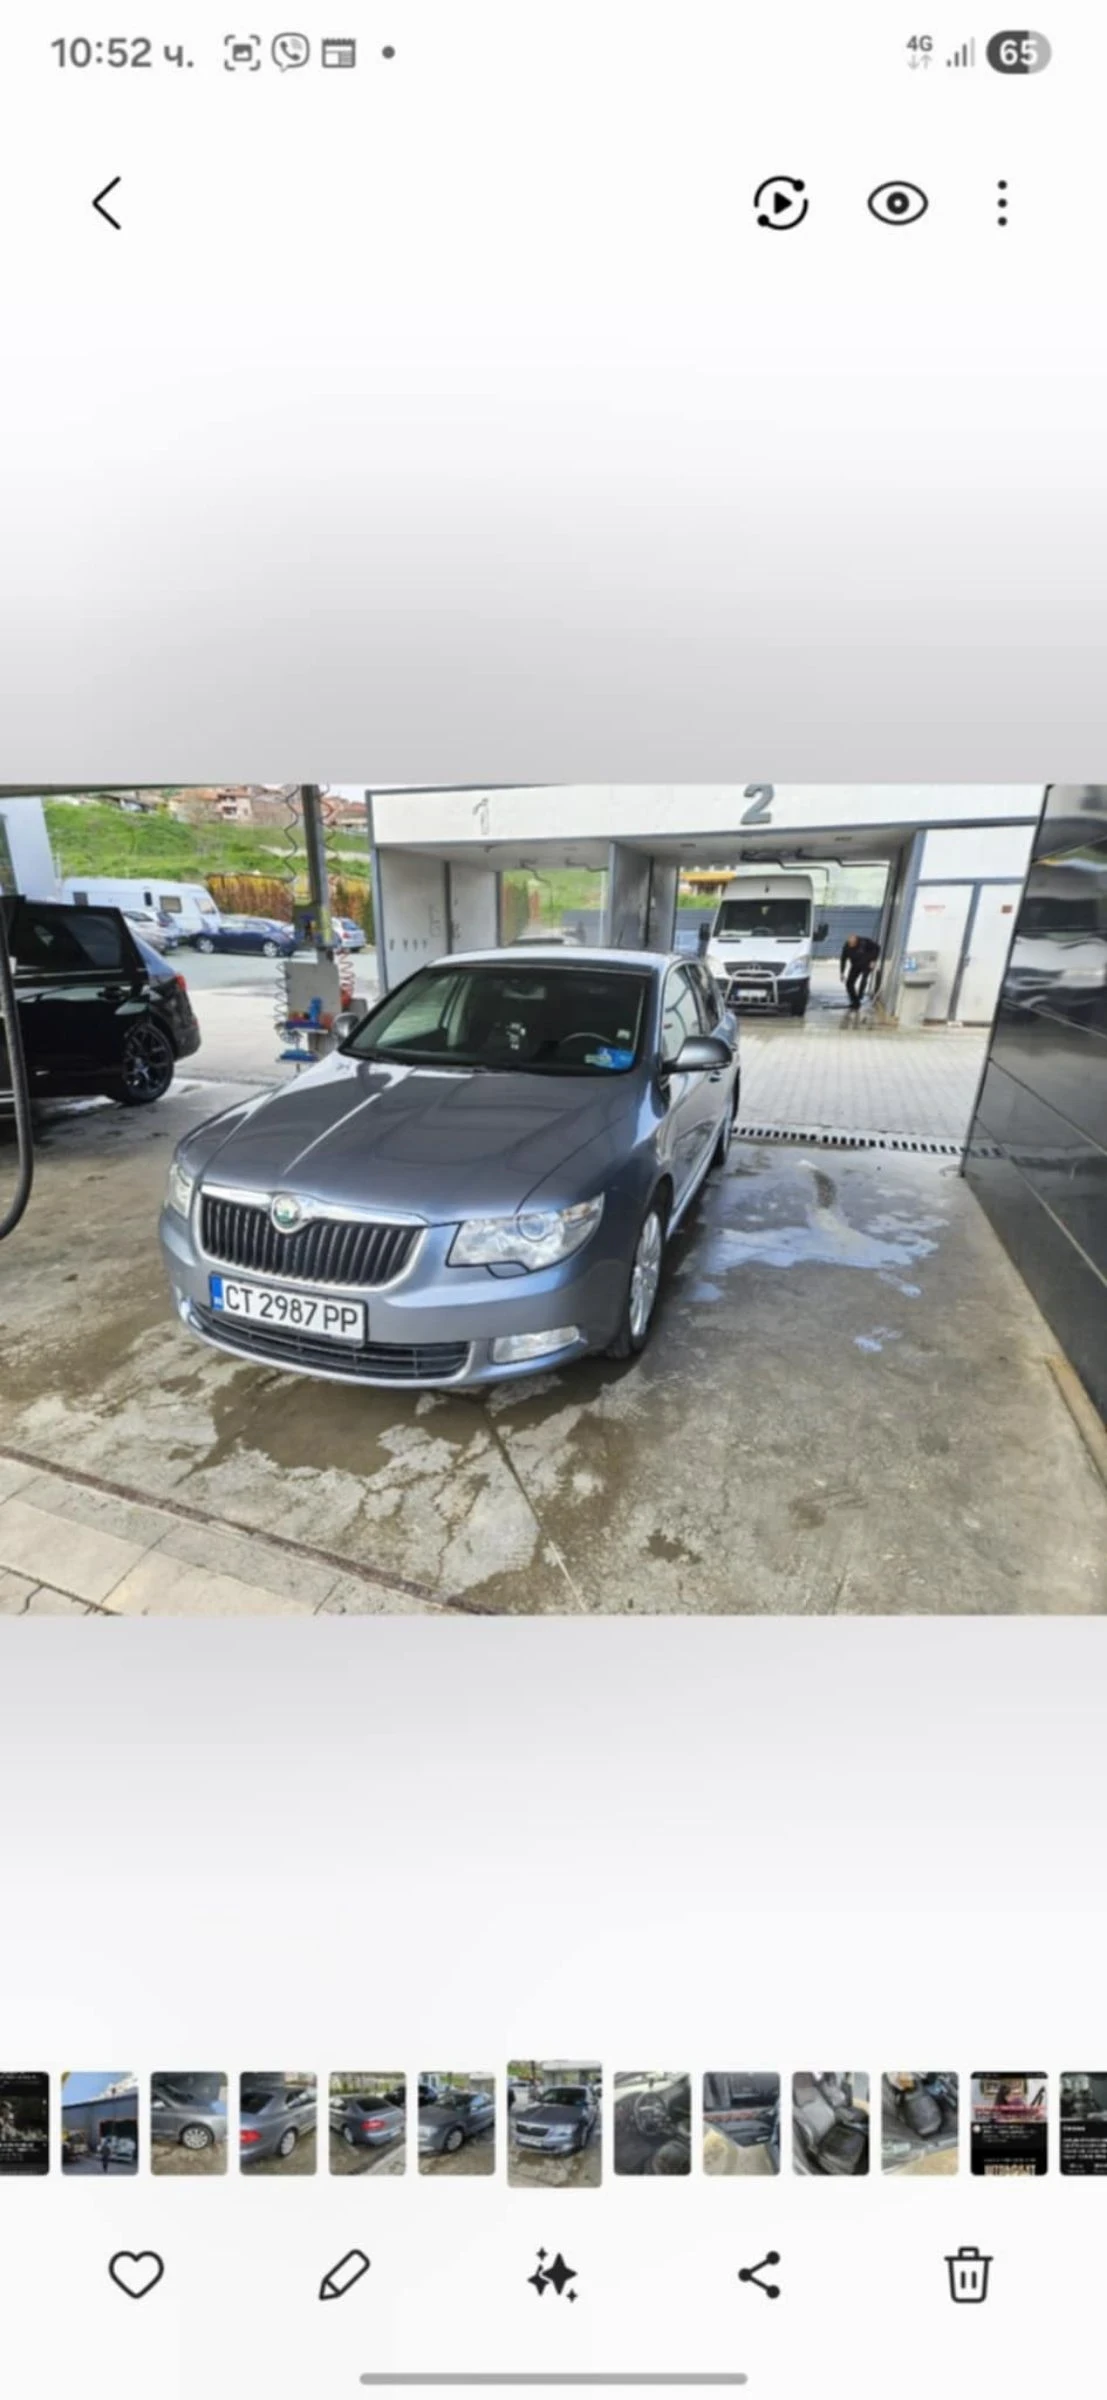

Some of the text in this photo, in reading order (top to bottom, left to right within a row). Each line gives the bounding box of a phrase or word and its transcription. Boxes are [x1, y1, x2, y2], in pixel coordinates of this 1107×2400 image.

[51, 37, 194, 68] 10:52 ч.
[906, 34, 933, 52] 4G
[1000, 39, 1038, 66] 65
[472, 797, 489, 836] 1
[740, 783, 774, 825] 2
[226, 1285, 253, 1313] CT
[259, 1293, 317, 1326] 2987
[324, 1304, 357, 1333] PP
